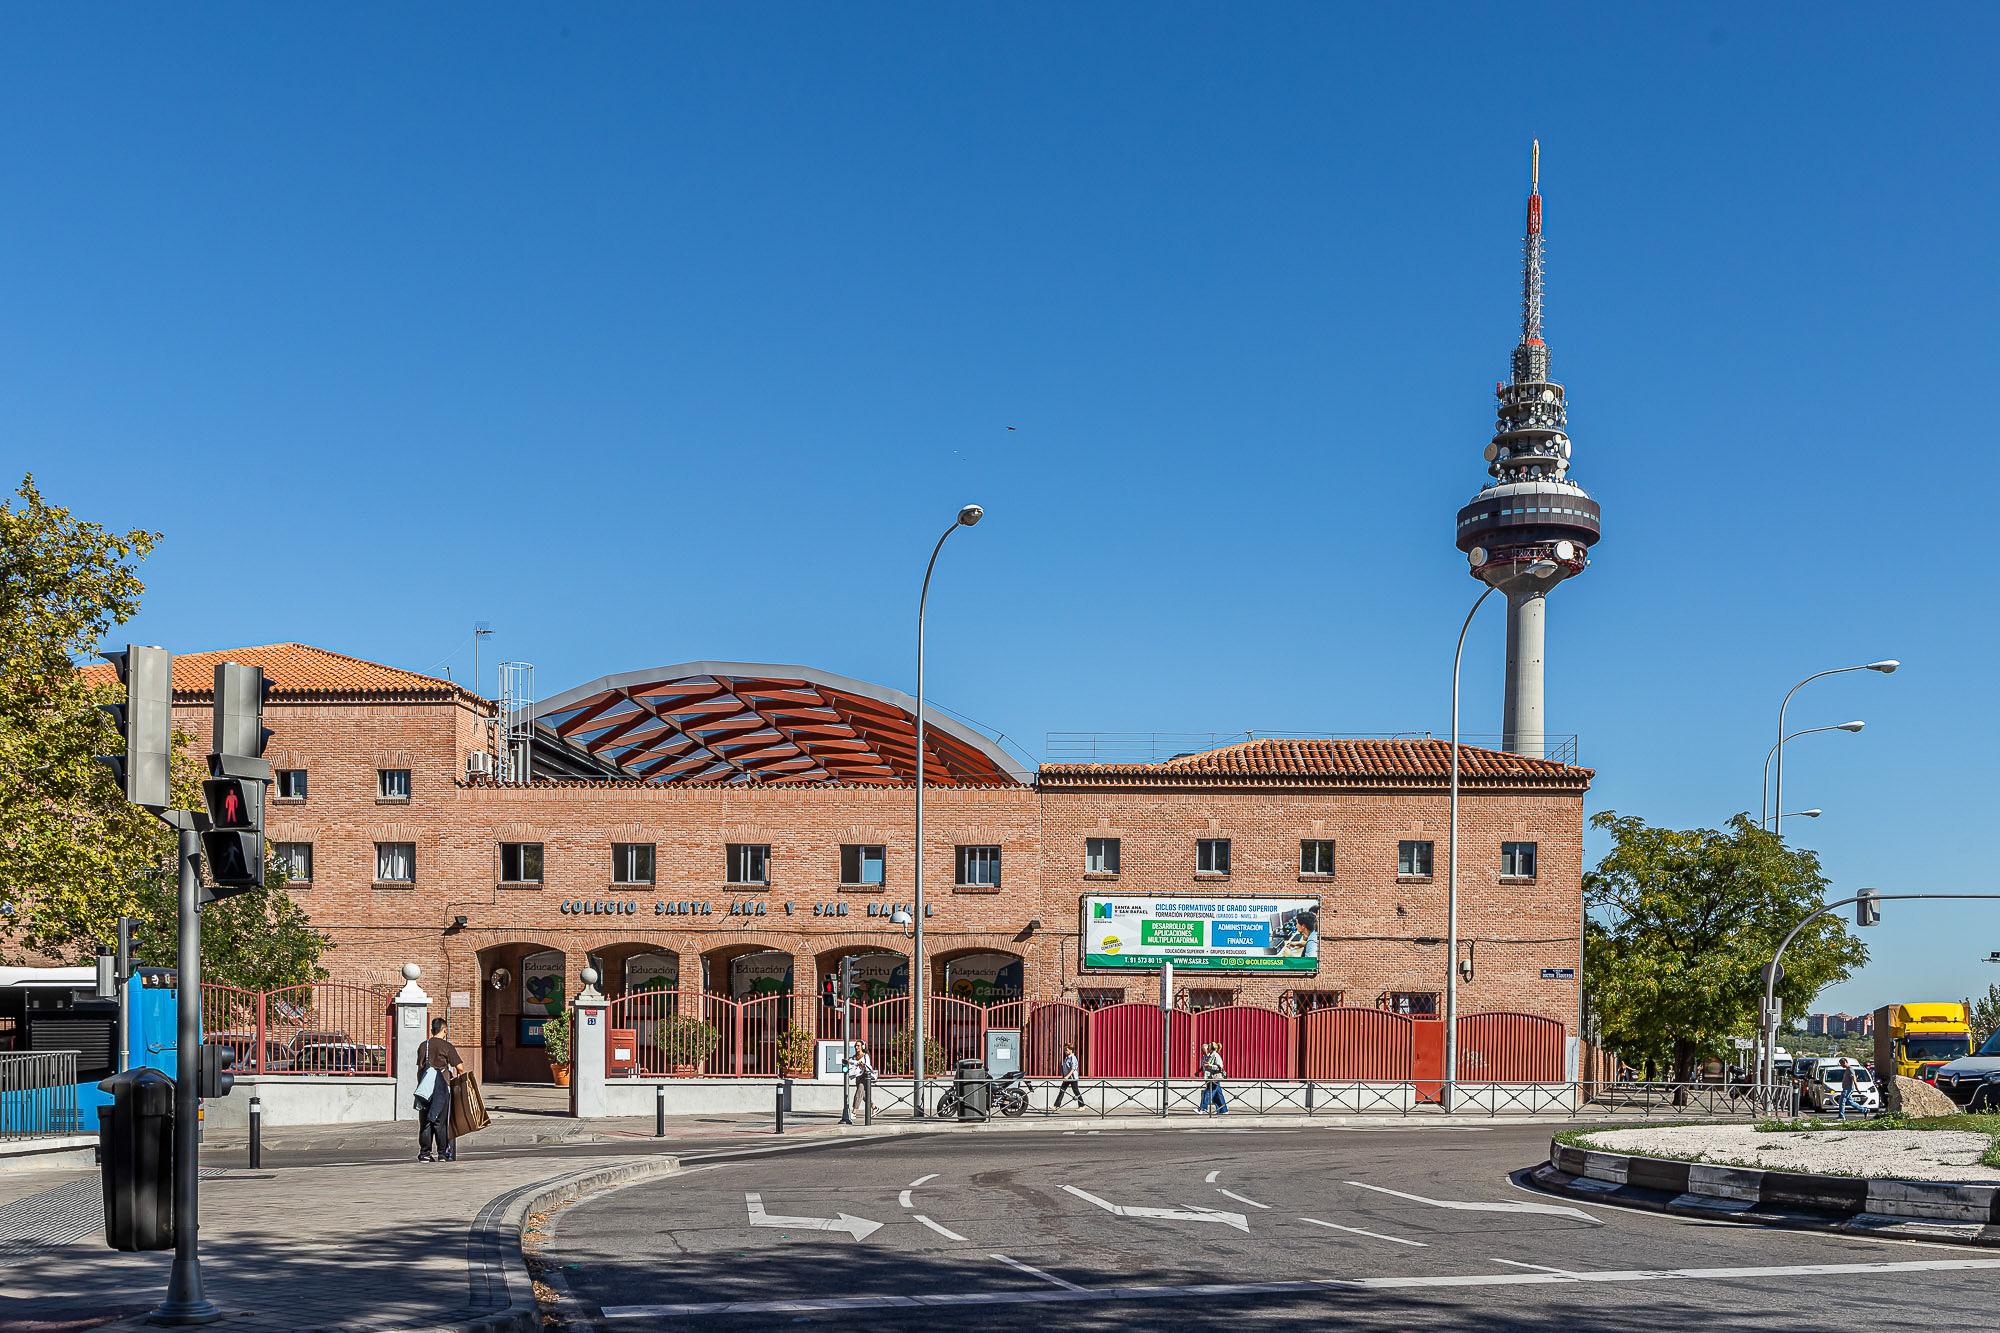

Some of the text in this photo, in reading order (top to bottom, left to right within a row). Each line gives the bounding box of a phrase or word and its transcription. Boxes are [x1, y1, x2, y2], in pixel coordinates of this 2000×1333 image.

[561, 900, 934, 916] COLEGIO SANTA ANA Y SAN RAFAL
[1155, 903, 1278, 912] CICLOS FORMATIVOS DE GRADO SUPERIOR
[1151, 922, 1186, 930] DESARROLLO
[1217, 923, 1264, 931] ADMINISTRACIÓN
[1147, 936, 1199, 944] MULTIPLATAFORMA
[1173, 957, 1209, 965] WWW.SASR.ES
[524, 962, 565, 972] Educació
[631, 965, 677, 975] Educación
[736, 964, 785, 974] Educación
[951, 967, 997, 977] Adaptación
